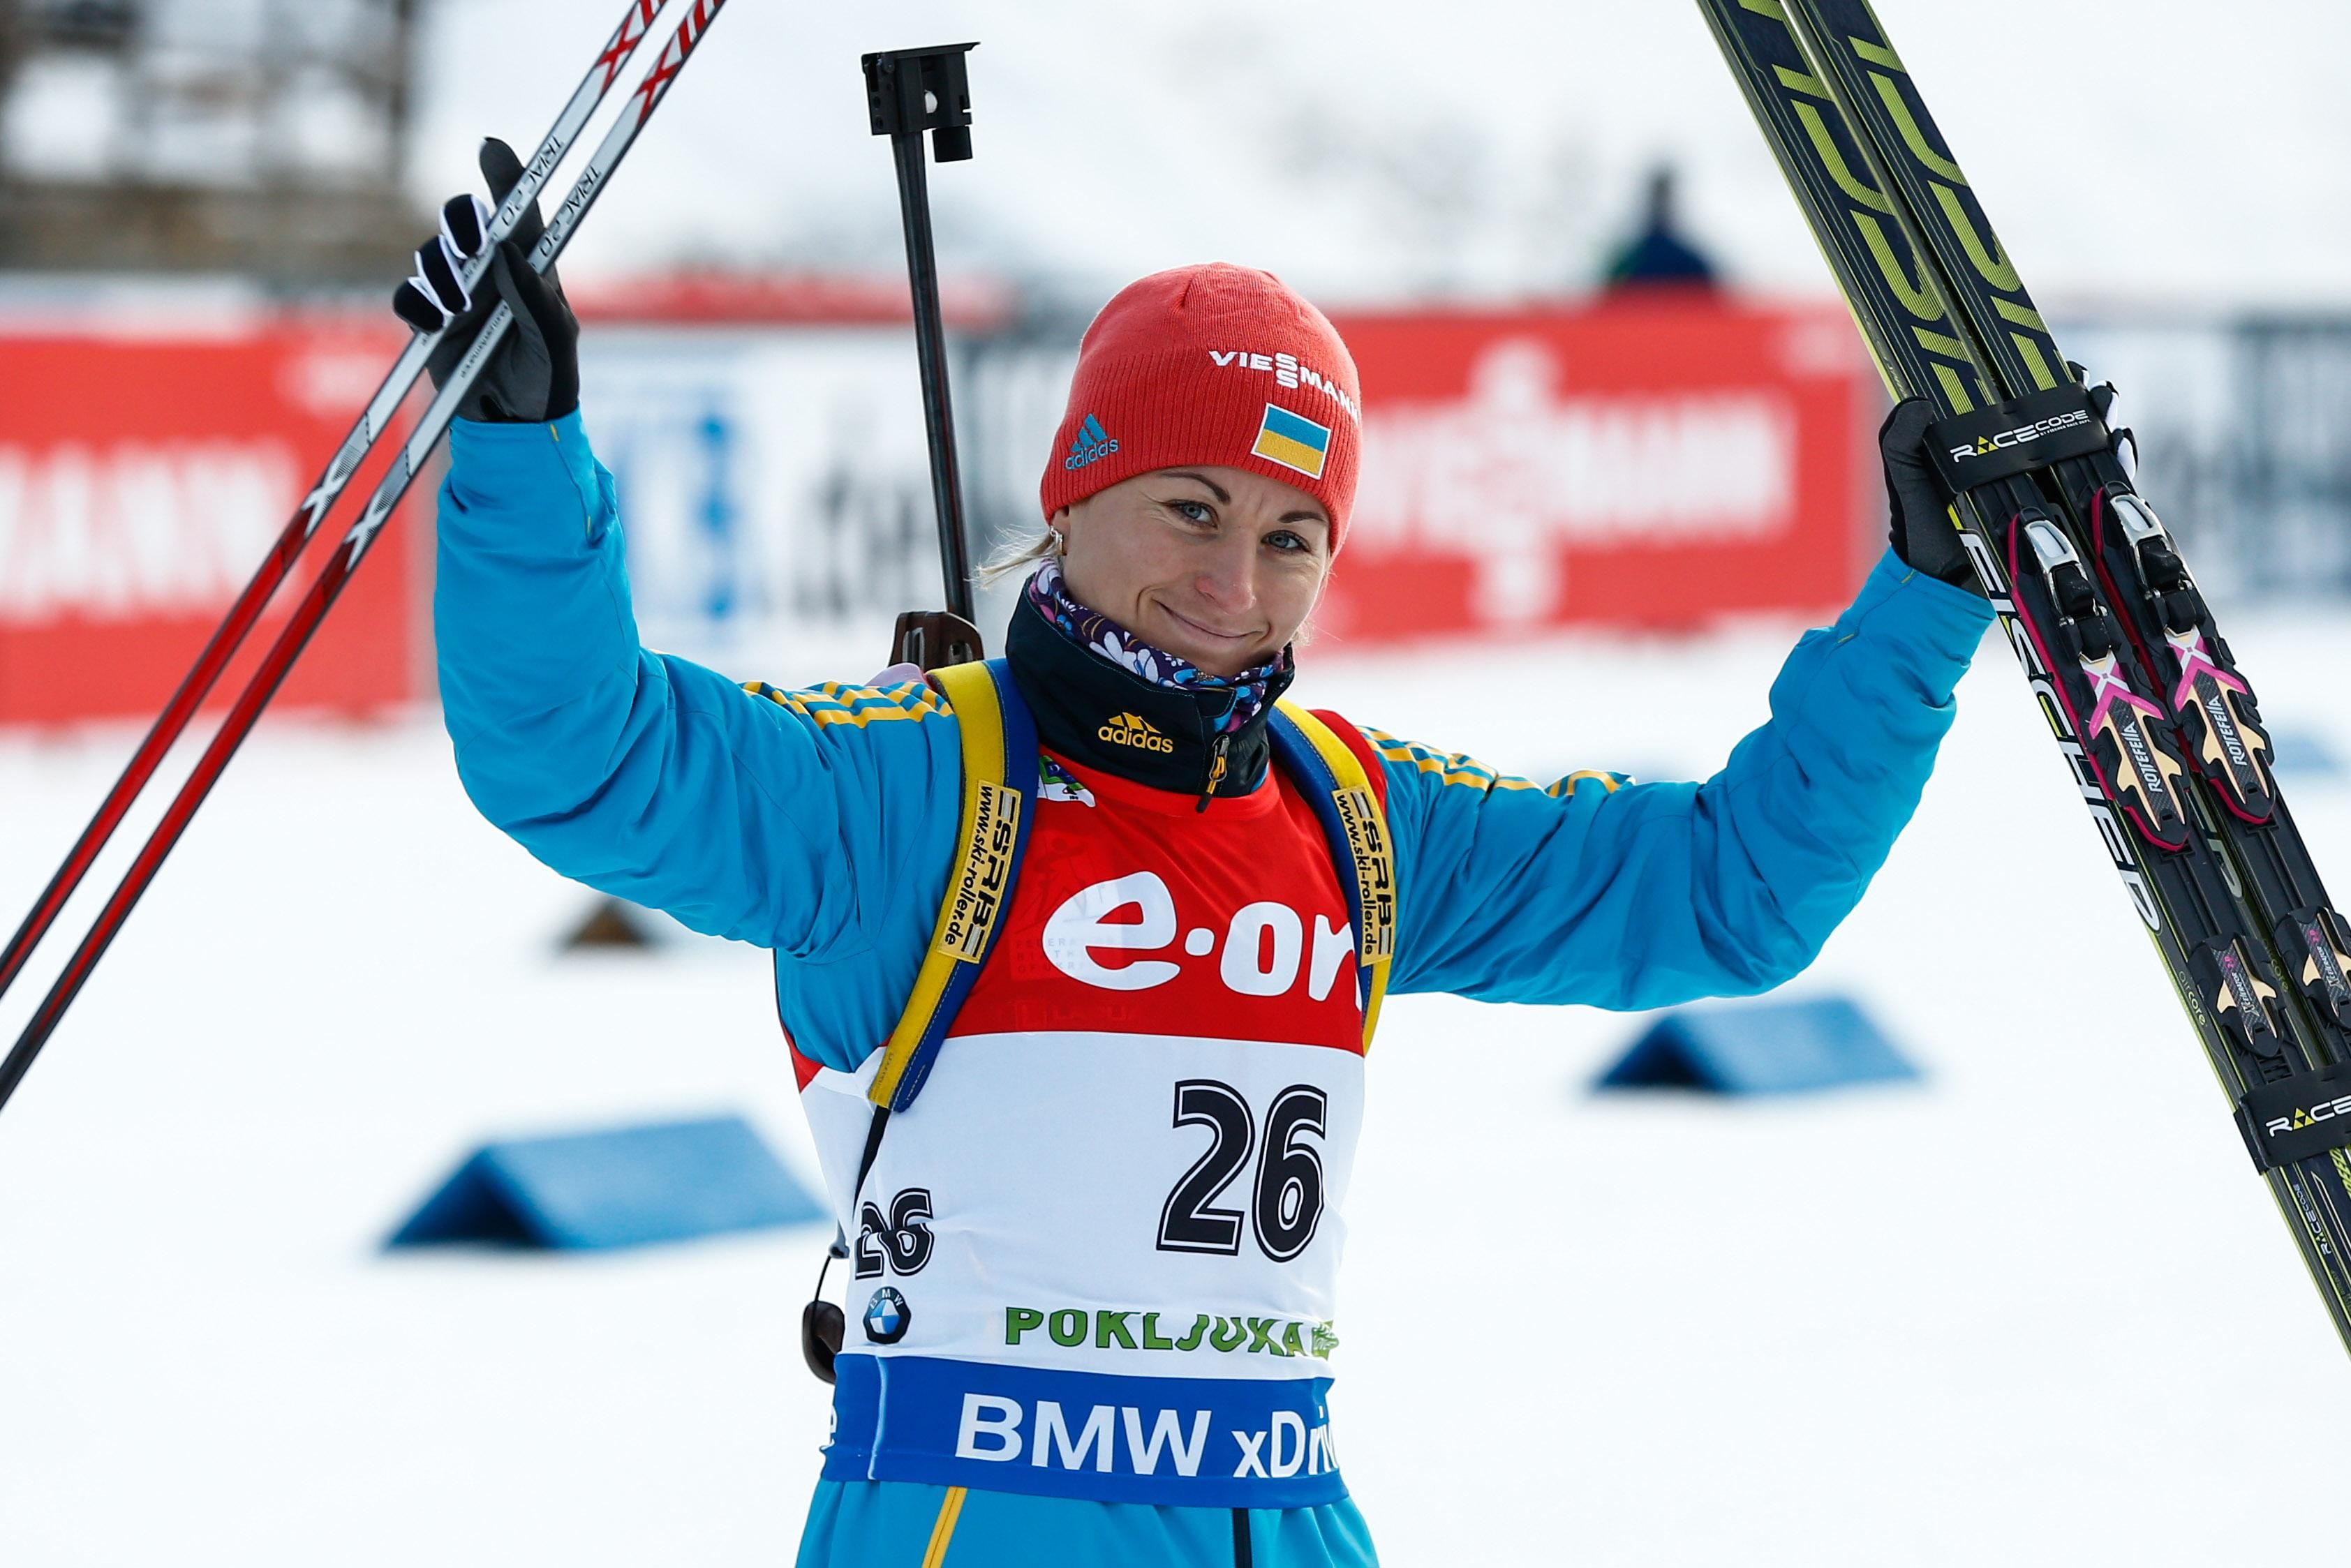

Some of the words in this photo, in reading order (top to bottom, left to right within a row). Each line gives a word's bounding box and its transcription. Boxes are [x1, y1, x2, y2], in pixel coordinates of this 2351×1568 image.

[560, 165, 601, 225] TRIAC
[1065, 439, 1119, 470] adidas
[1098, 726, 1173, 754] adidas
[945, 786, 993, 945] www.ski-roller.de
[1337, 794, 1377, 955] www.ski-roller.de
[2178, 969, 2206, 1027] aircore
[1156, 1079, 1328, 1263] 26
[854, 1187, 935, 1280] 26
[870, 1288, 904, 1310] BMW
[1005, 1306, 1309, 1357] POKLJUKA
[956, 1391, 1212, 1478] BMW
